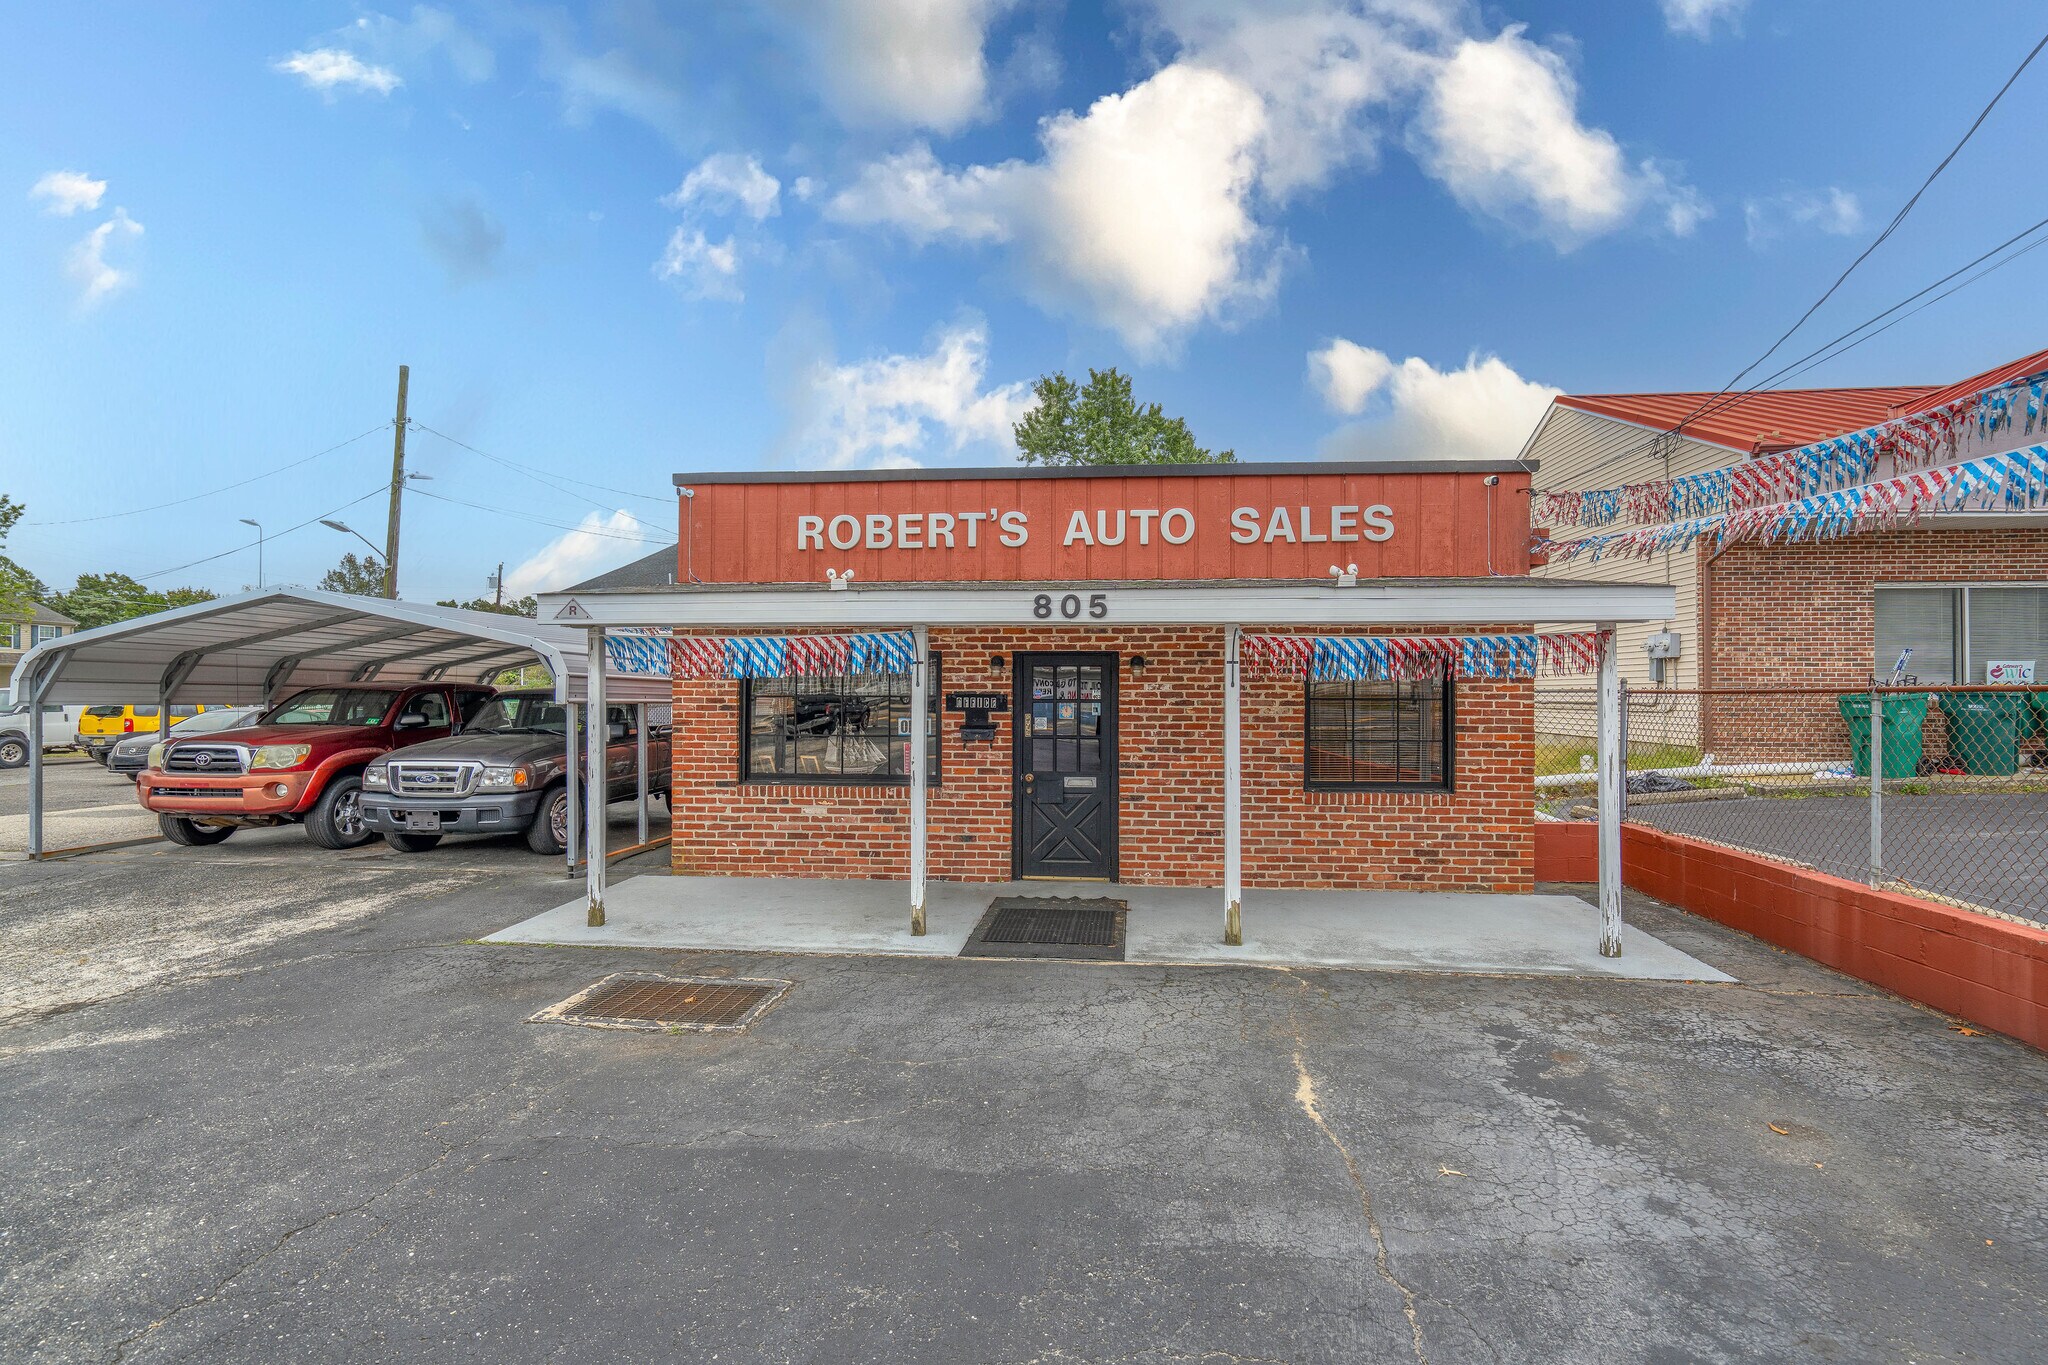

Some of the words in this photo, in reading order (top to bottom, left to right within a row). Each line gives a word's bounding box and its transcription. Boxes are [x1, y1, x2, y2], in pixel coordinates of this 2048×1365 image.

[797, 507, 1028, 551] ROBERT'S
[1062, 507, 1197, 547] AUTO
[1230, 504, 1395, 544] SALES
[569, 605, 577, 616] R
[1033, 594, 1108, 618] 805
[419, 775, 434, 783] Ford
